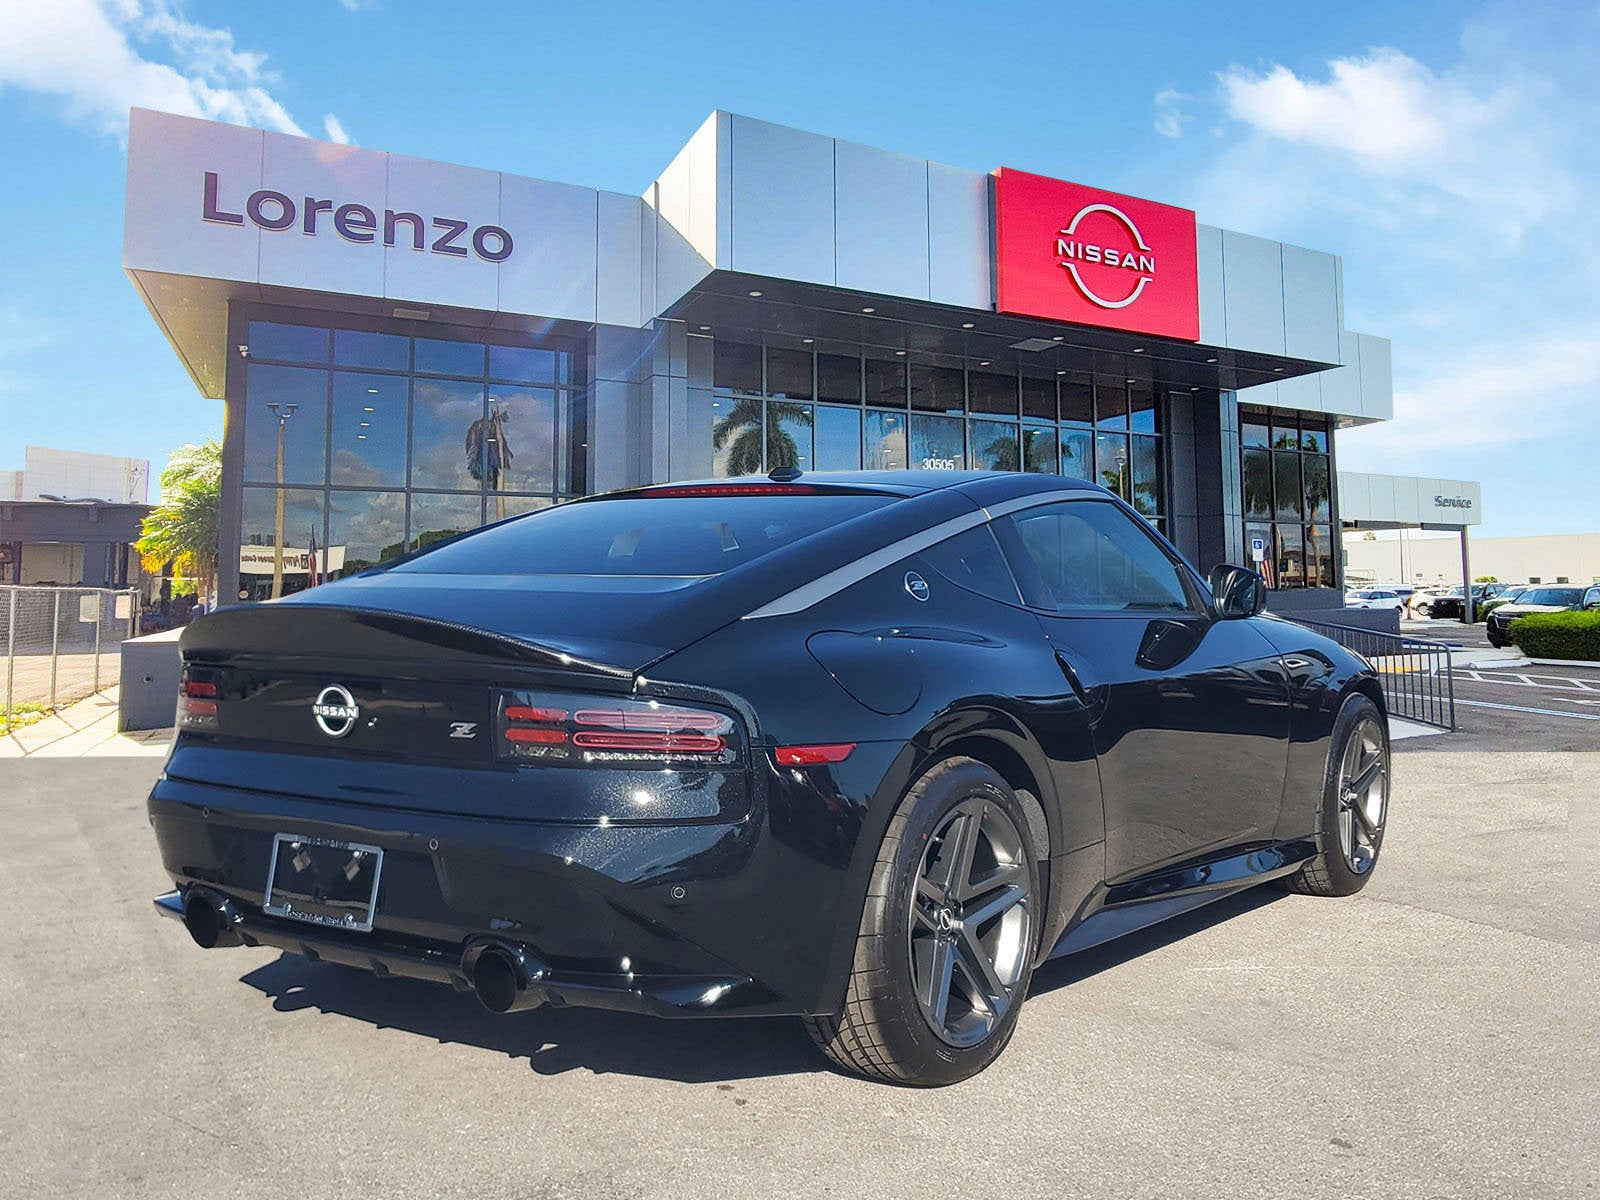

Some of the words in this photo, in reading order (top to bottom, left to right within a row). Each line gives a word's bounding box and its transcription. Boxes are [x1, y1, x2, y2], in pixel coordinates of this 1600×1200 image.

[202, 171, 513, 263] Lorenzo
[1057, 237, 1156, 274] NISSAN
[922, 458, 954, 470] 30505
[1434, 495, 1472, 508] Service
[312, 704, 358, 718] NISSAN
[449, 721, 478, 739] Z
